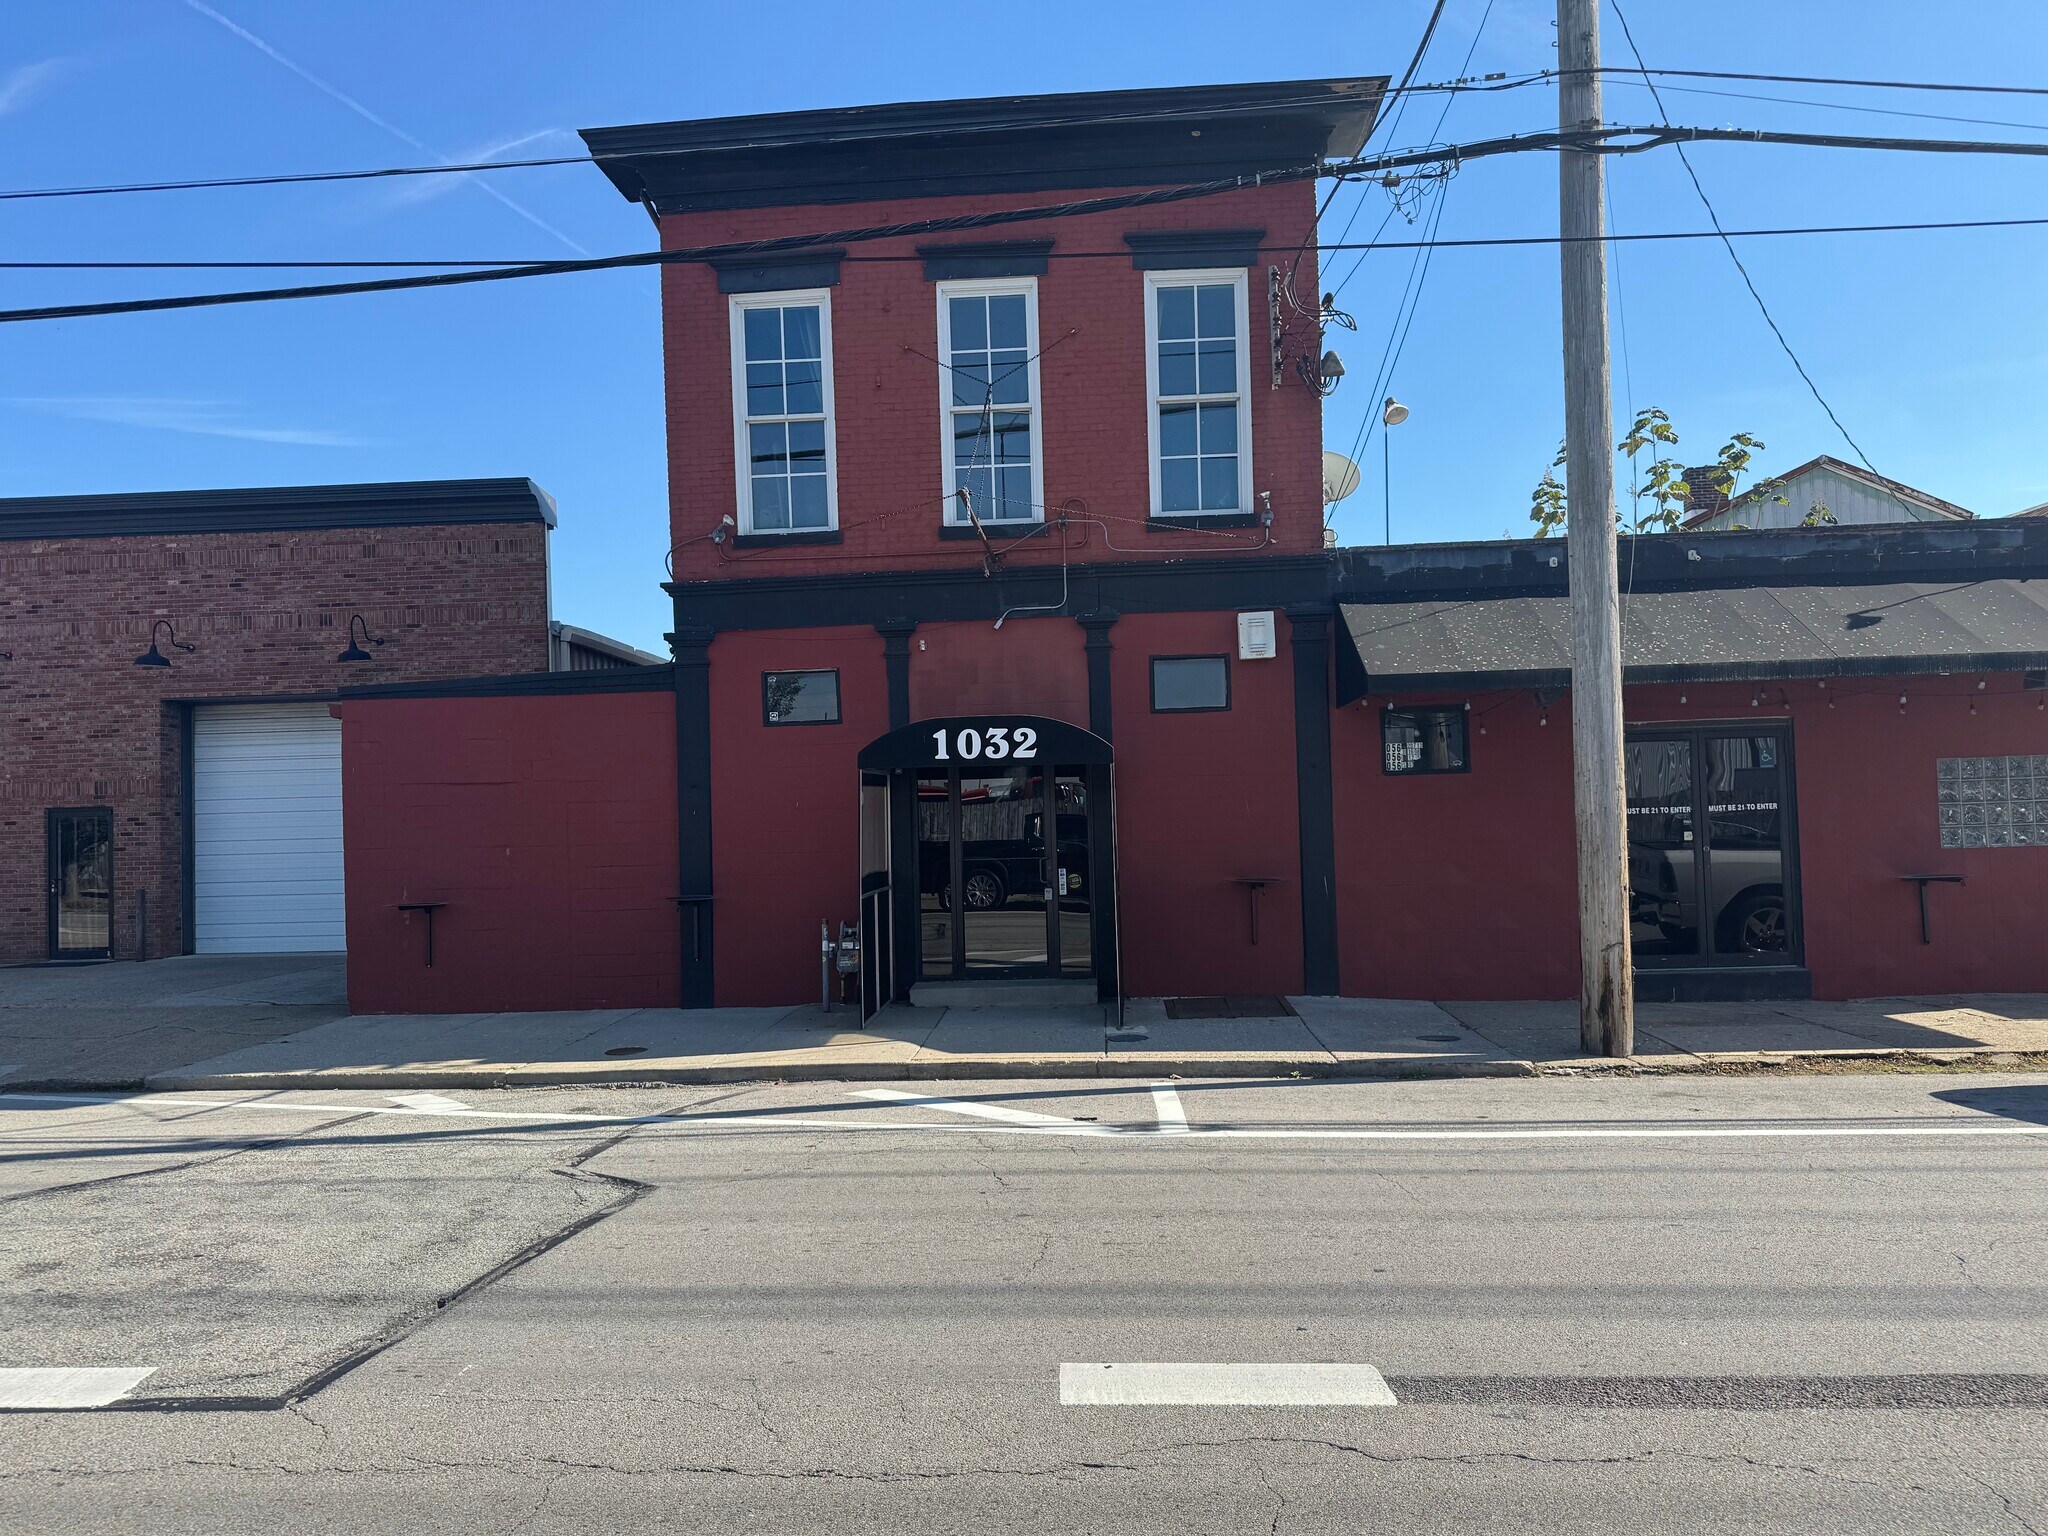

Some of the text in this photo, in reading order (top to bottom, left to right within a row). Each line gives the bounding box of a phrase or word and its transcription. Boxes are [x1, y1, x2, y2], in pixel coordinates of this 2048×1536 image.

[932, 727, 1037, 760] 1032
[1627, 807, 1640, 815] UST
[1660, 806, 1669, 814] TO
[1670, 806, 1691, 814] ENTER
[1708, 804, 1726, 812] MUST
[1756, 802, 1778, 810] ENTER
